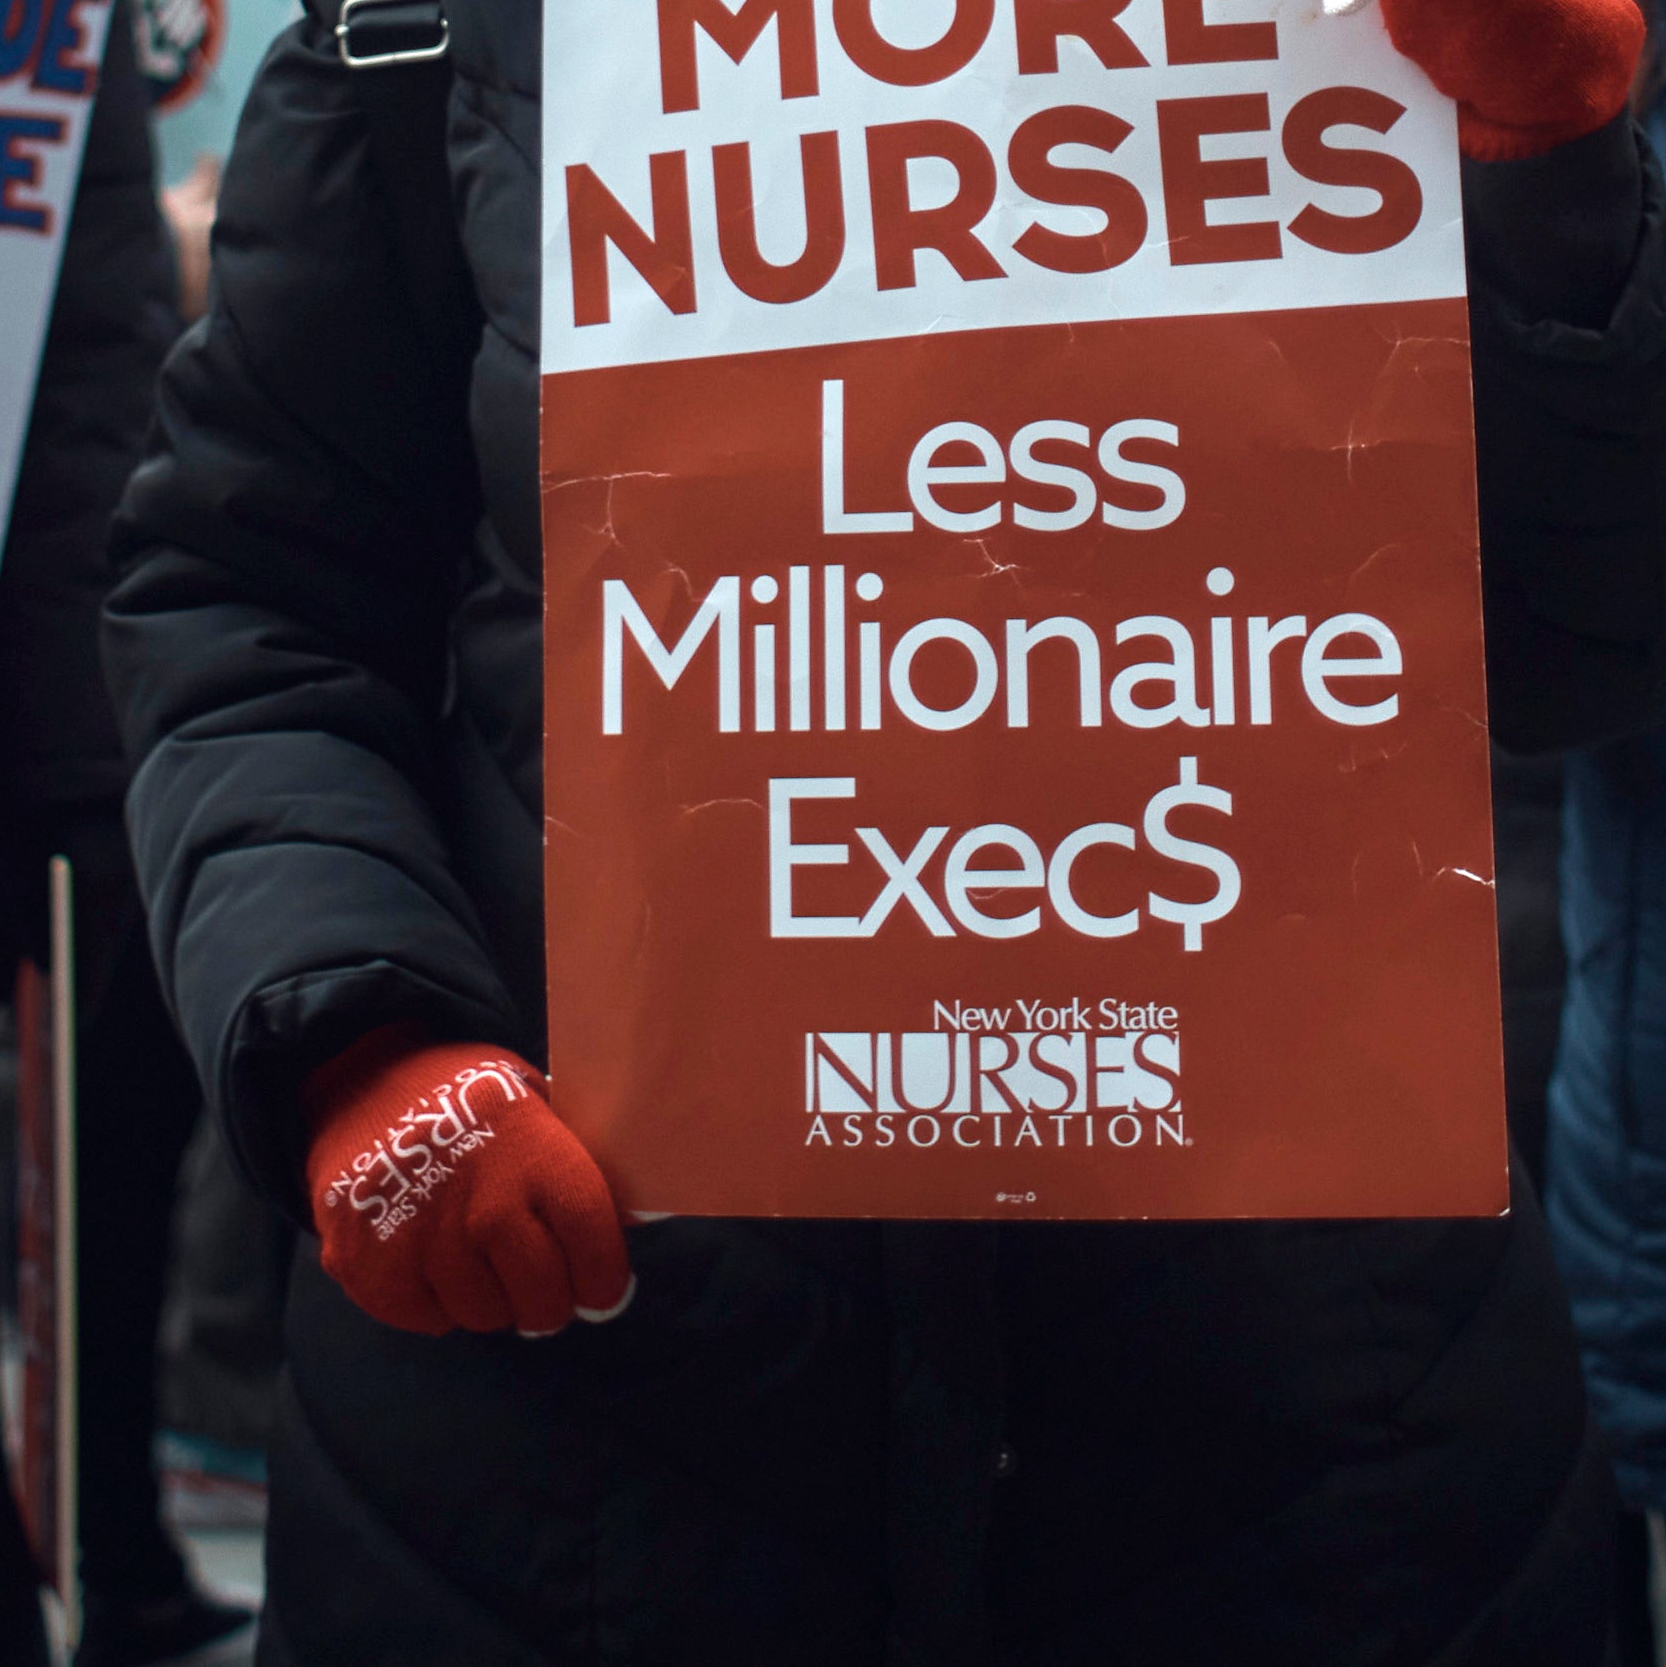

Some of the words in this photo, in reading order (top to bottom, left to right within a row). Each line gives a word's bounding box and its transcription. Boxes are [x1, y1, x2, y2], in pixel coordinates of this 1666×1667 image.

[564, 85, 1424, 329] NURSES
[822, 379, 1187, 534] Less
[601, 564, 1403, 736] Millionaire
[769, 756, 1242, 952] Exec$
[933, 999, 1011, 1031] New
[1016, 997, 1092, 1031] York
[1099, 997, 1178, 1031] State
[805, 1031, 1181, 1113] NURSES
[411, 1161, 454, 1201] York
[450, 1122, 495, 1163] New
[377, 1196, 417, 1241] State
